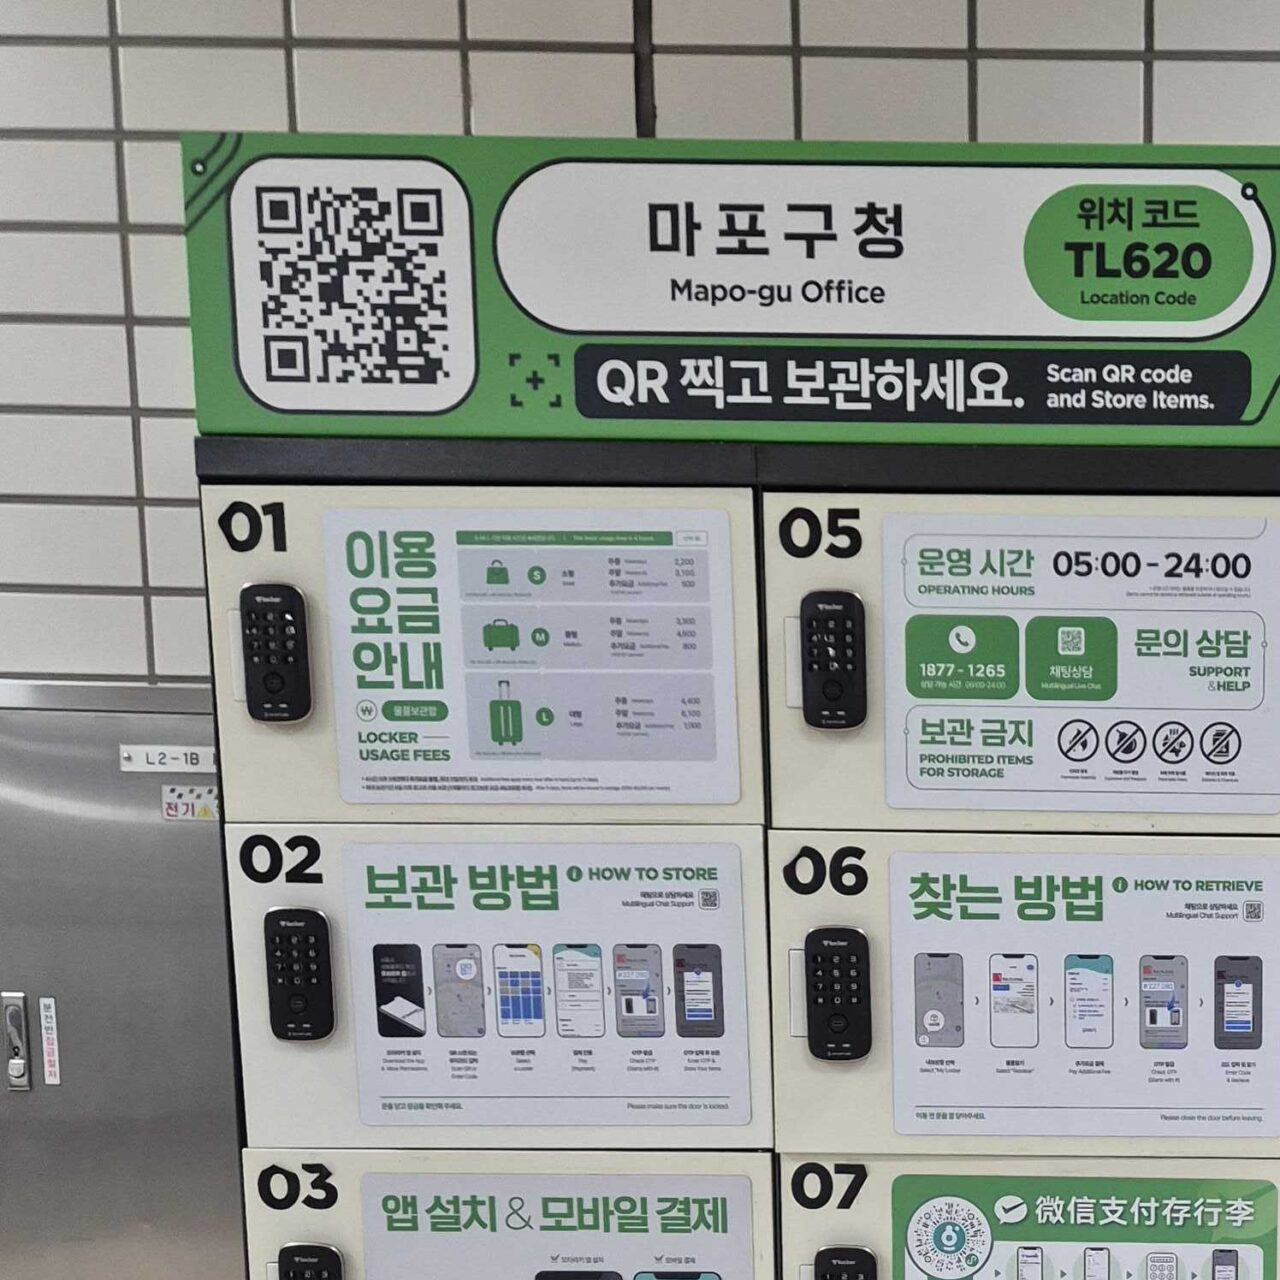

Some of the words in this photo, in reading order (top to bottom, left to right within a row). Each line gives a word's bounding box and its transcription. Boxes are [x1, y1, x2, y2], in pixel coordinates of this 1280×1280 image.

[1077, 199, 1133, 231] 위치
[1143, 199, 1200, 231] 코드
[648, 201, 905, 260] 마포구청
[1065, 242, 1212, 279] TL620
[670, 278, 792, 307] Mapo-gu
[801, 280, 886, 304] Office
[1080, 291, 1150, 306] Location
[1155, 291, 1197, 306] Code
[597, 360, 670, 406] QR
[680, 358, 773, 408] 찍고
[783, 358, 1025, 412] 보관하세요.
[1046, 364, 1097, 384] Scan
[1103, 364, 1135, 384] QR
[1141, 364, 1192, 384] code
[1046, 390, 1086, 409] and
[1091, 390, 1147, 409] Store
[1152, 390, 1215, 409] Items.
[218, 501, 287, 552] 01
[779, 507, 862, 559] 05
[345, 530, 437, 579] 이용
[918, 548, 972, 578] 운영
[979, 548, 1034, 578] 시간
[917, 584, 989, 596] OPERATING
[991, 584, 1035, 596] HOURS
[350, 587, 441, 635] 요금
[1134, 629, 1189, 658] 문의
[1195, 629, 1252, 658] 상담
[353, 642, 444, 690] 안내
[920, 663, 954, 677] 1877
[968, 663, 1006, 678] 1265
[1049, 664, 1093, 679] 채팅상담
[1188, 666, 1251, 677] SUPPORT
[1208, 681, 1251, 692] &HELP
[358, 732, 419, 744] LOCKER
[919, 718, 974, 748] 보관
[980, 718, 1034, 748] 금지
[145, 752, 200, 766] L2-1B
[359, 749, 411, 762] USAGE
[413, 749, 451, 762] FEES
[919, 754, 993, 766] PROHIBITED
[996, 754, 1034, 766] ITEMS
[919, 767, 944, 778] FOR
[947, 767, 1005, 778] STORAGE
[165, 802, 195, 817] 전기
[239, 834, 323, 884] 02
[588, 866, 635, 881] HOW
[638, 866, 659, 881] TO
[661, 866, 718, 881] STORE
[783, 846, 868, 896] 06
[365, 864, 458, 911] 보관
[468, 864, 560, 911] 방법
[908, 872, 1002, 921] 찾는
[1014, 872, 1104, 921] 방법
[1134, 879, 1171, 892] HOW
[1173, 879, 1193, 892] TO
[1196, 879, 1263, 892] RETRIEVE
[258, 1164, 338, 1210] 03
[791, 1162, 868, 1209] 07
[381, 1195, 419, 1232] 앱
[425, 1195, 497, 1233] 설치
[505, 1197, 533, 1230] &
[540, 1196, 649, 1233] 모바일
[655, 1196, 728, 1233] 결제
[1035, 1196, 1256, 1228] 微信支付存行李
